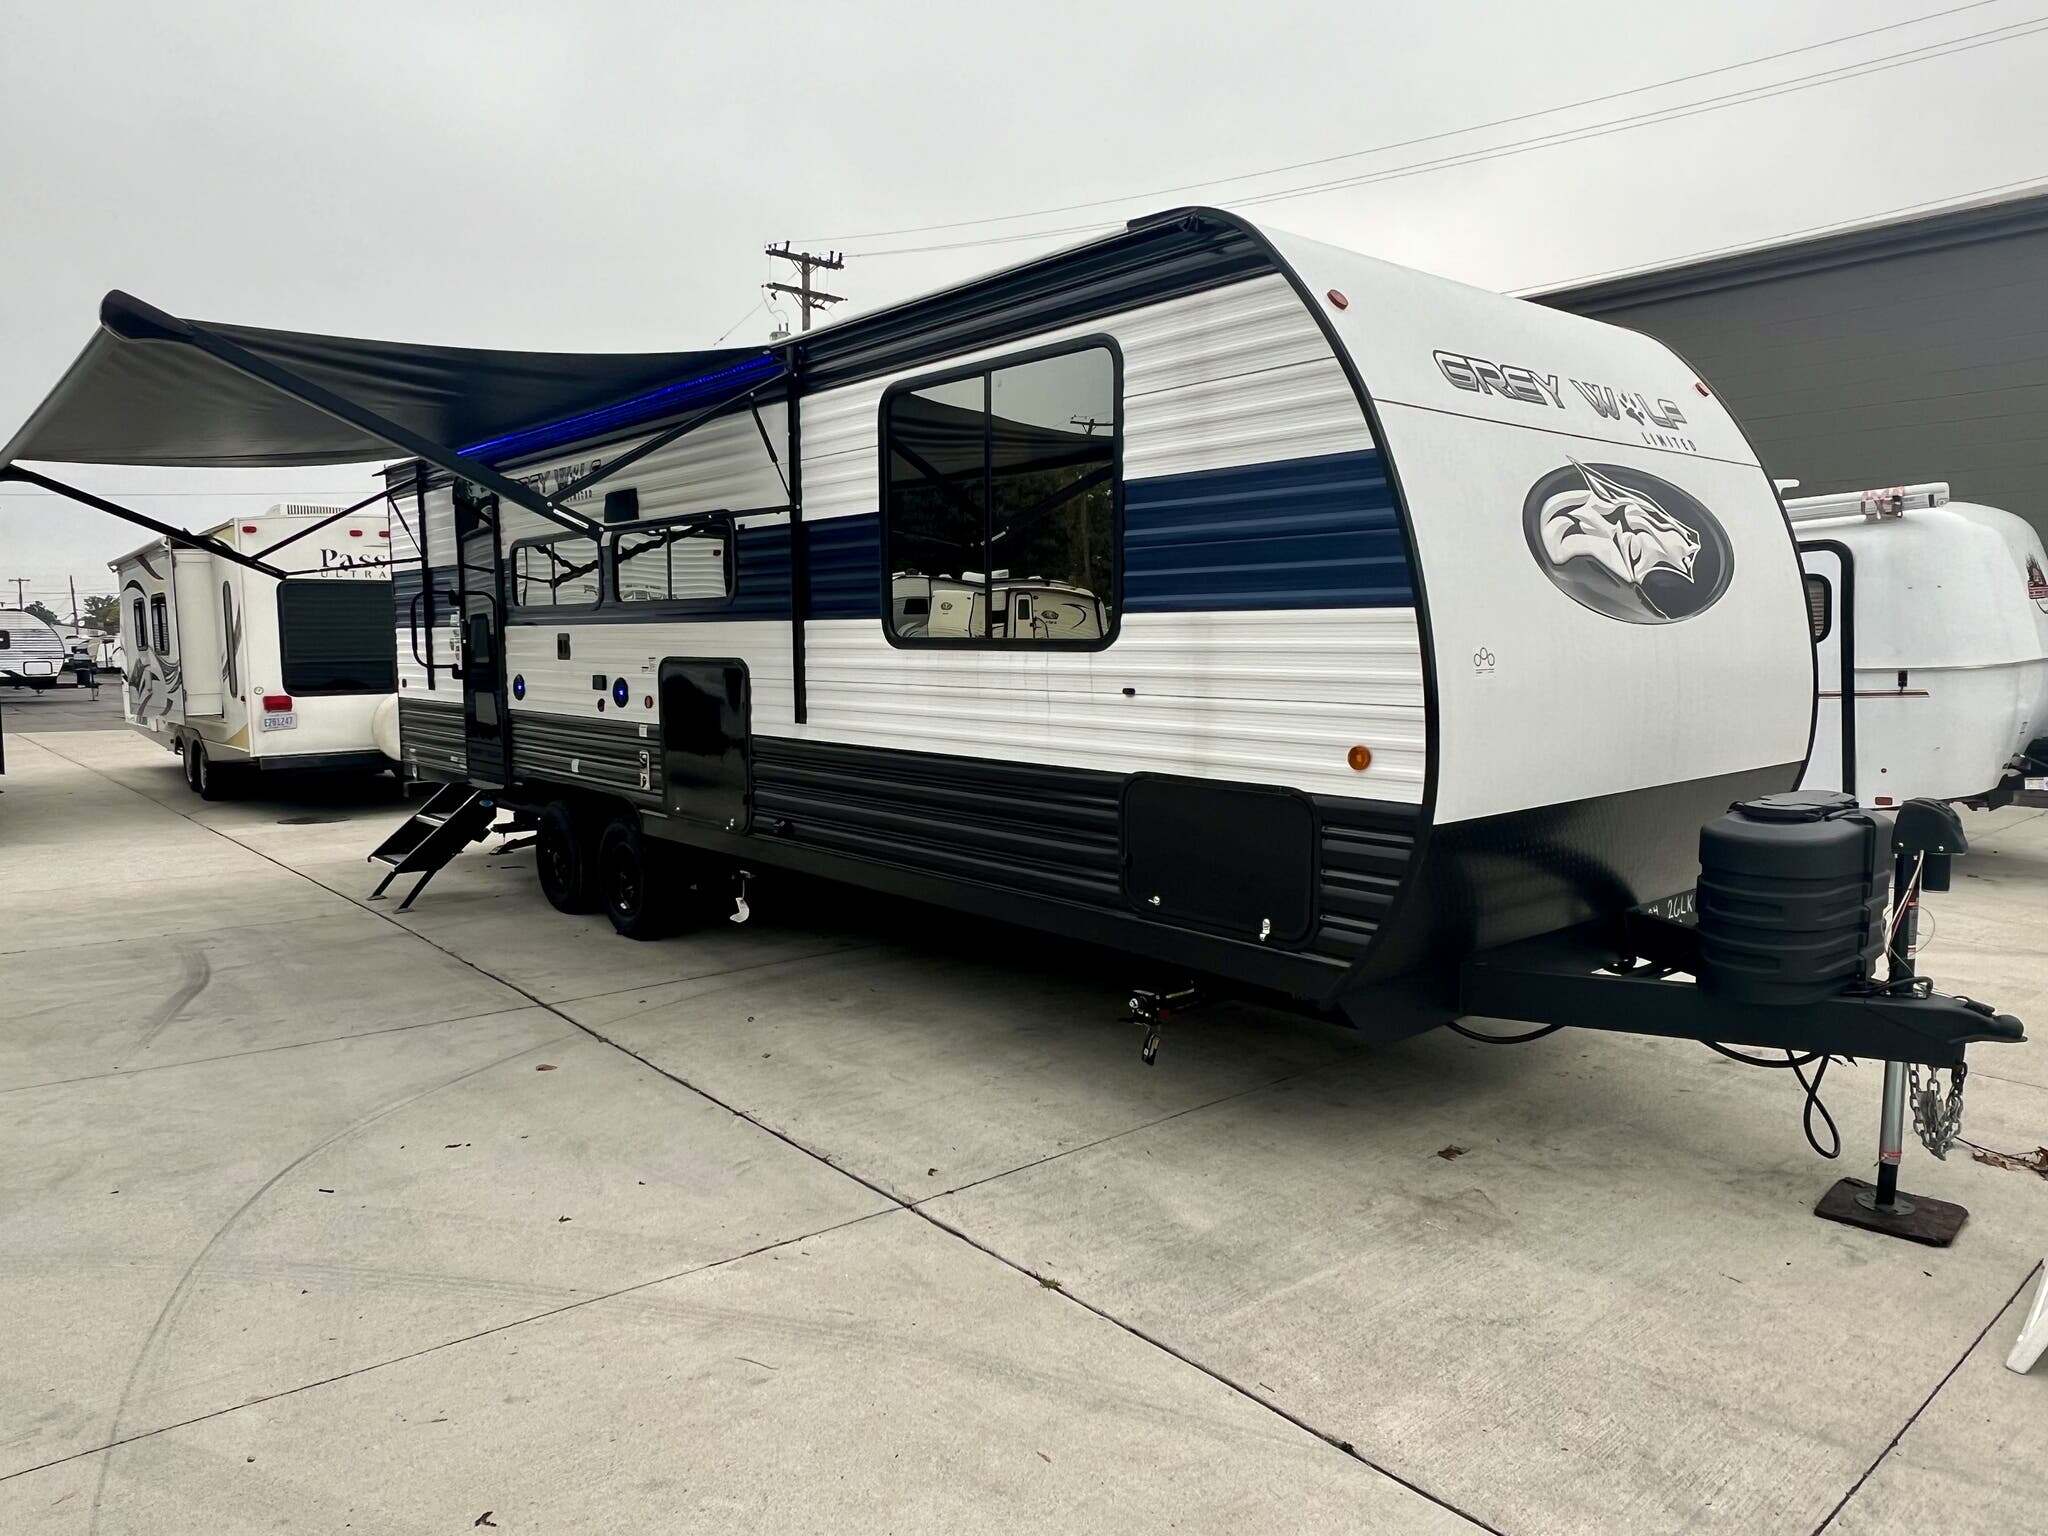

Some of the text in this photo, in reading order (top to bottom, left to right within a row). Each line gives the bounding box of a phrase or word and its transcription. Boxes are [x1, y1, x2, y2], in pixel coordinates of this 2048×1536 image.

[1432, 349, 1565, 409] GREY
[1641, 432, 1697, 451] LIMITED
[320, 569, 387, 579] ULTRA
